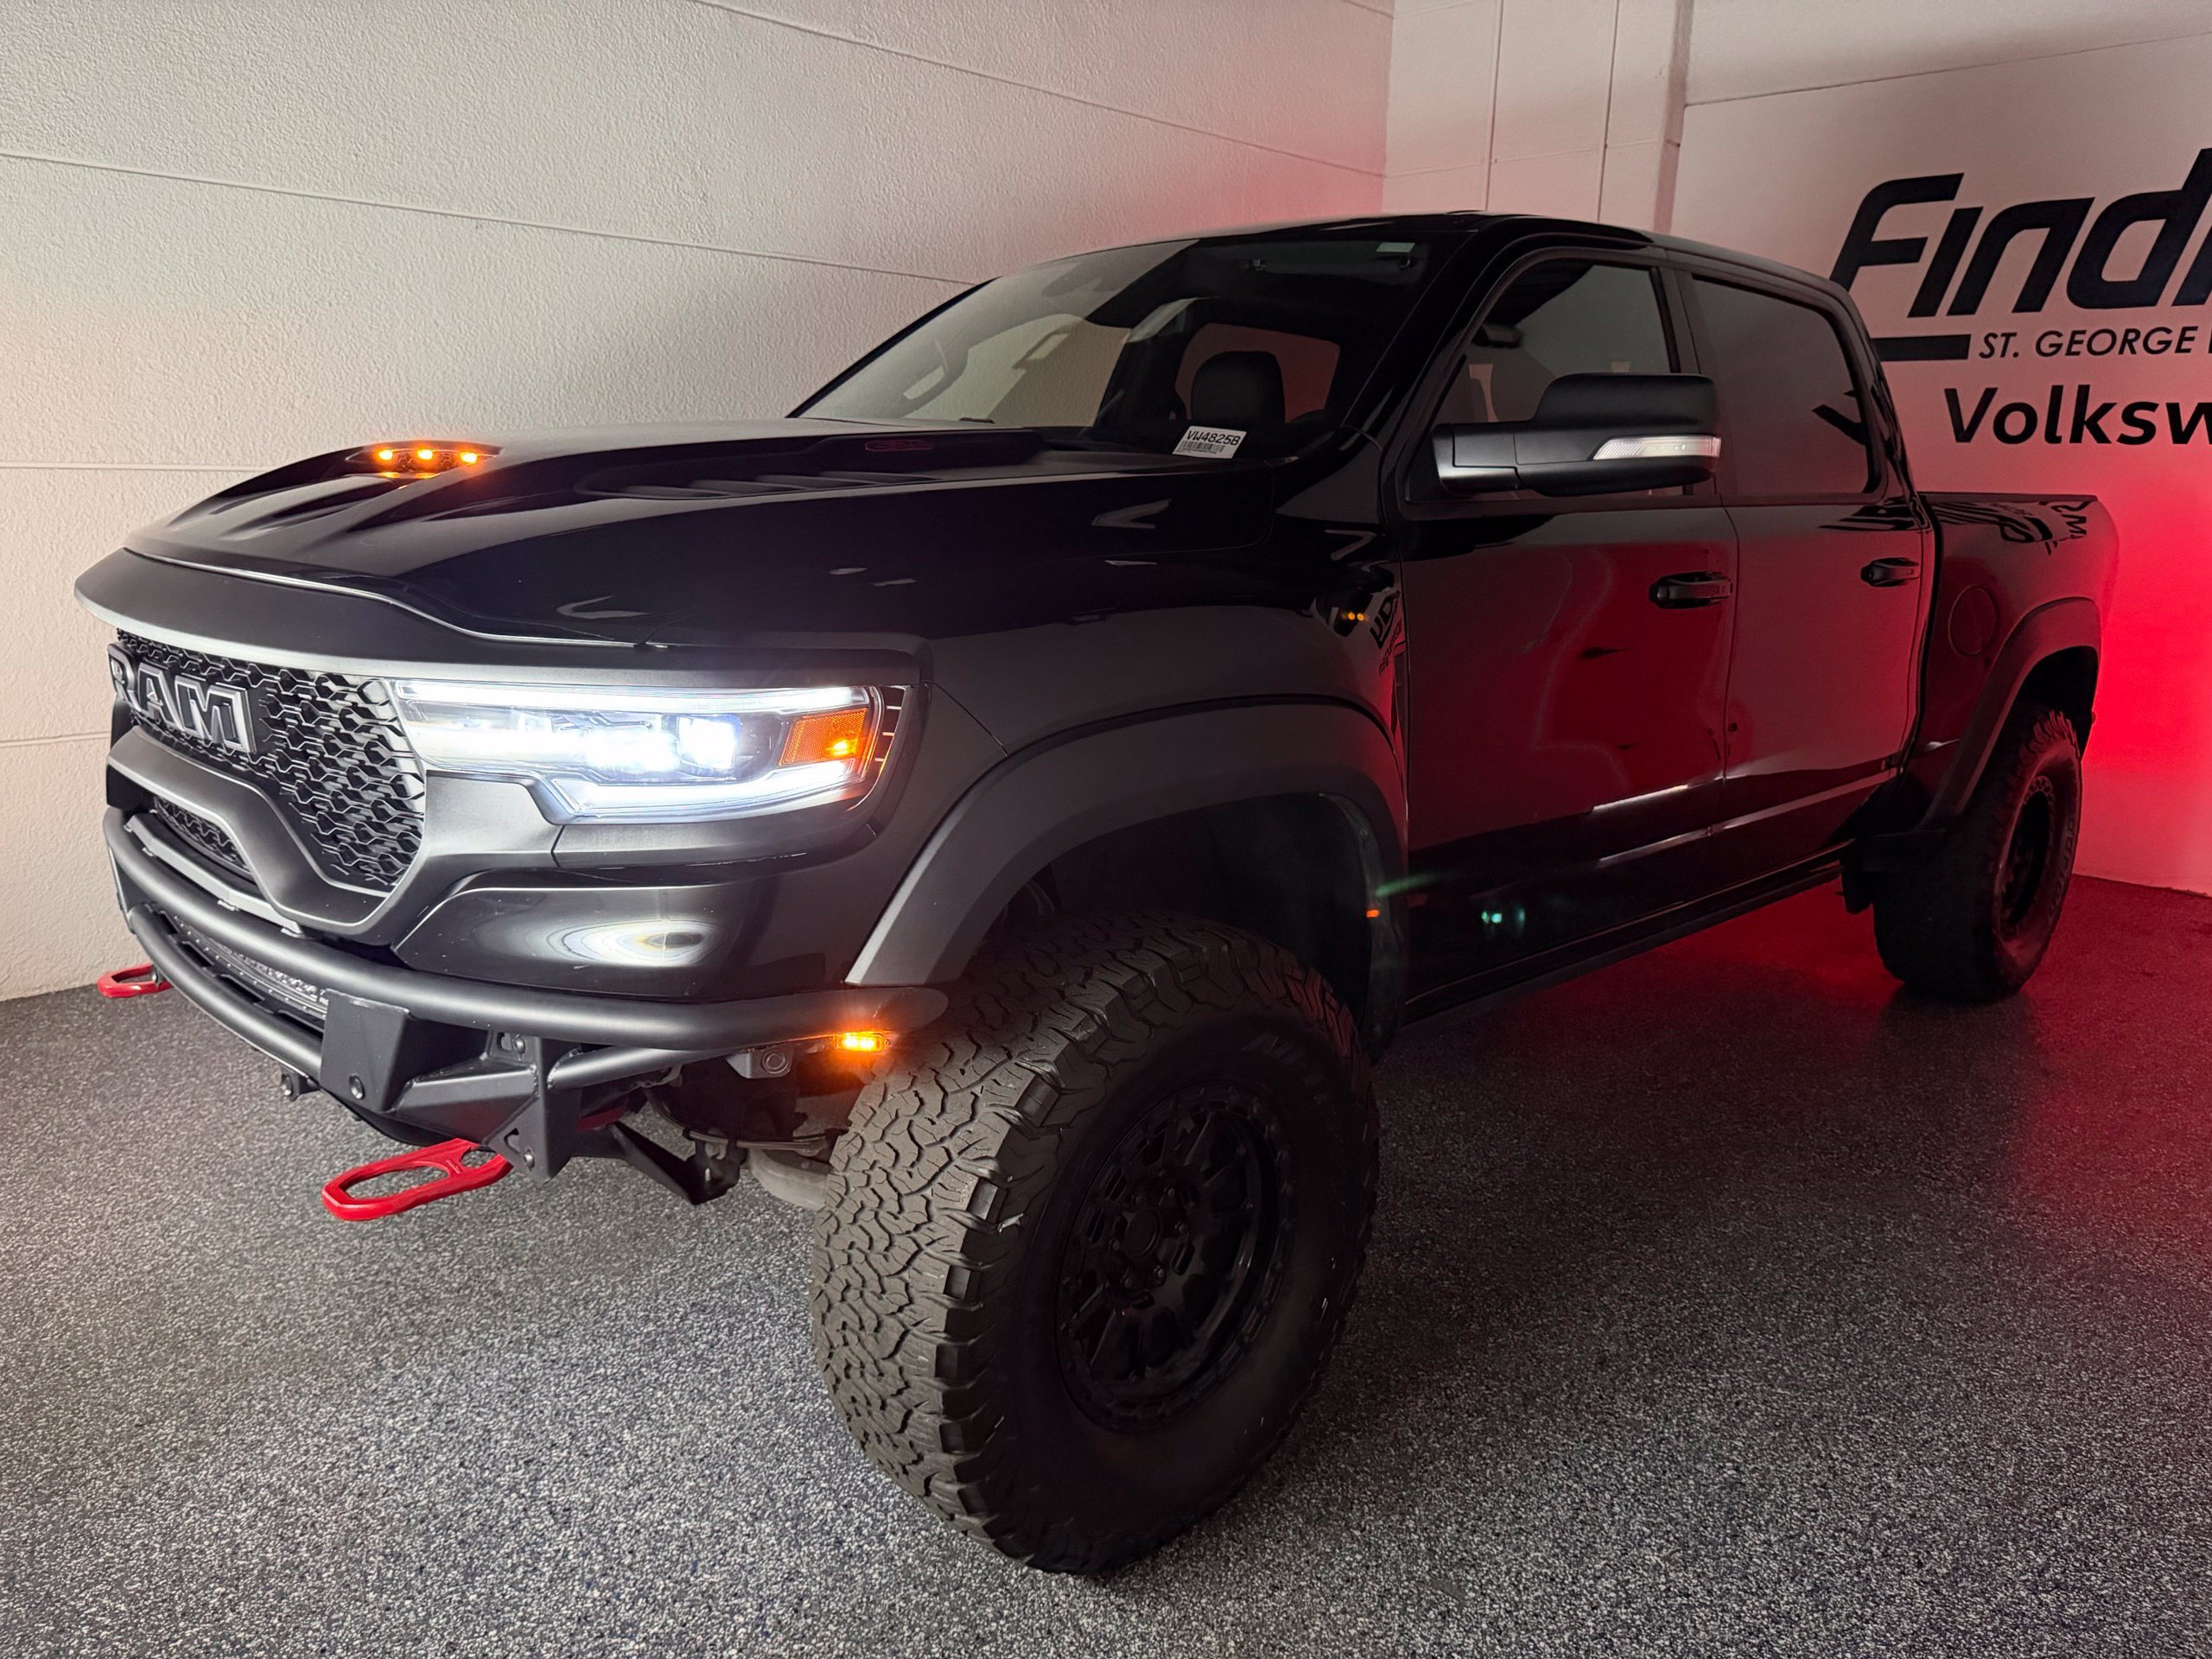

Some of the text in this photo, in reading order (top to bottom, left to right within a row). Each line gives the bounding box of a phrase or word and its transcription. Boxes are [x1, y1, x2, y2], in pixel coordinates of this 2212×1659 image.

[1979, 332, 2020, 359] ST.
[2035, 326, 2199, 357] GEORGE
[1186, 430, 1241, 446] VW4825B
[107, 644, 257, 753] RAM
